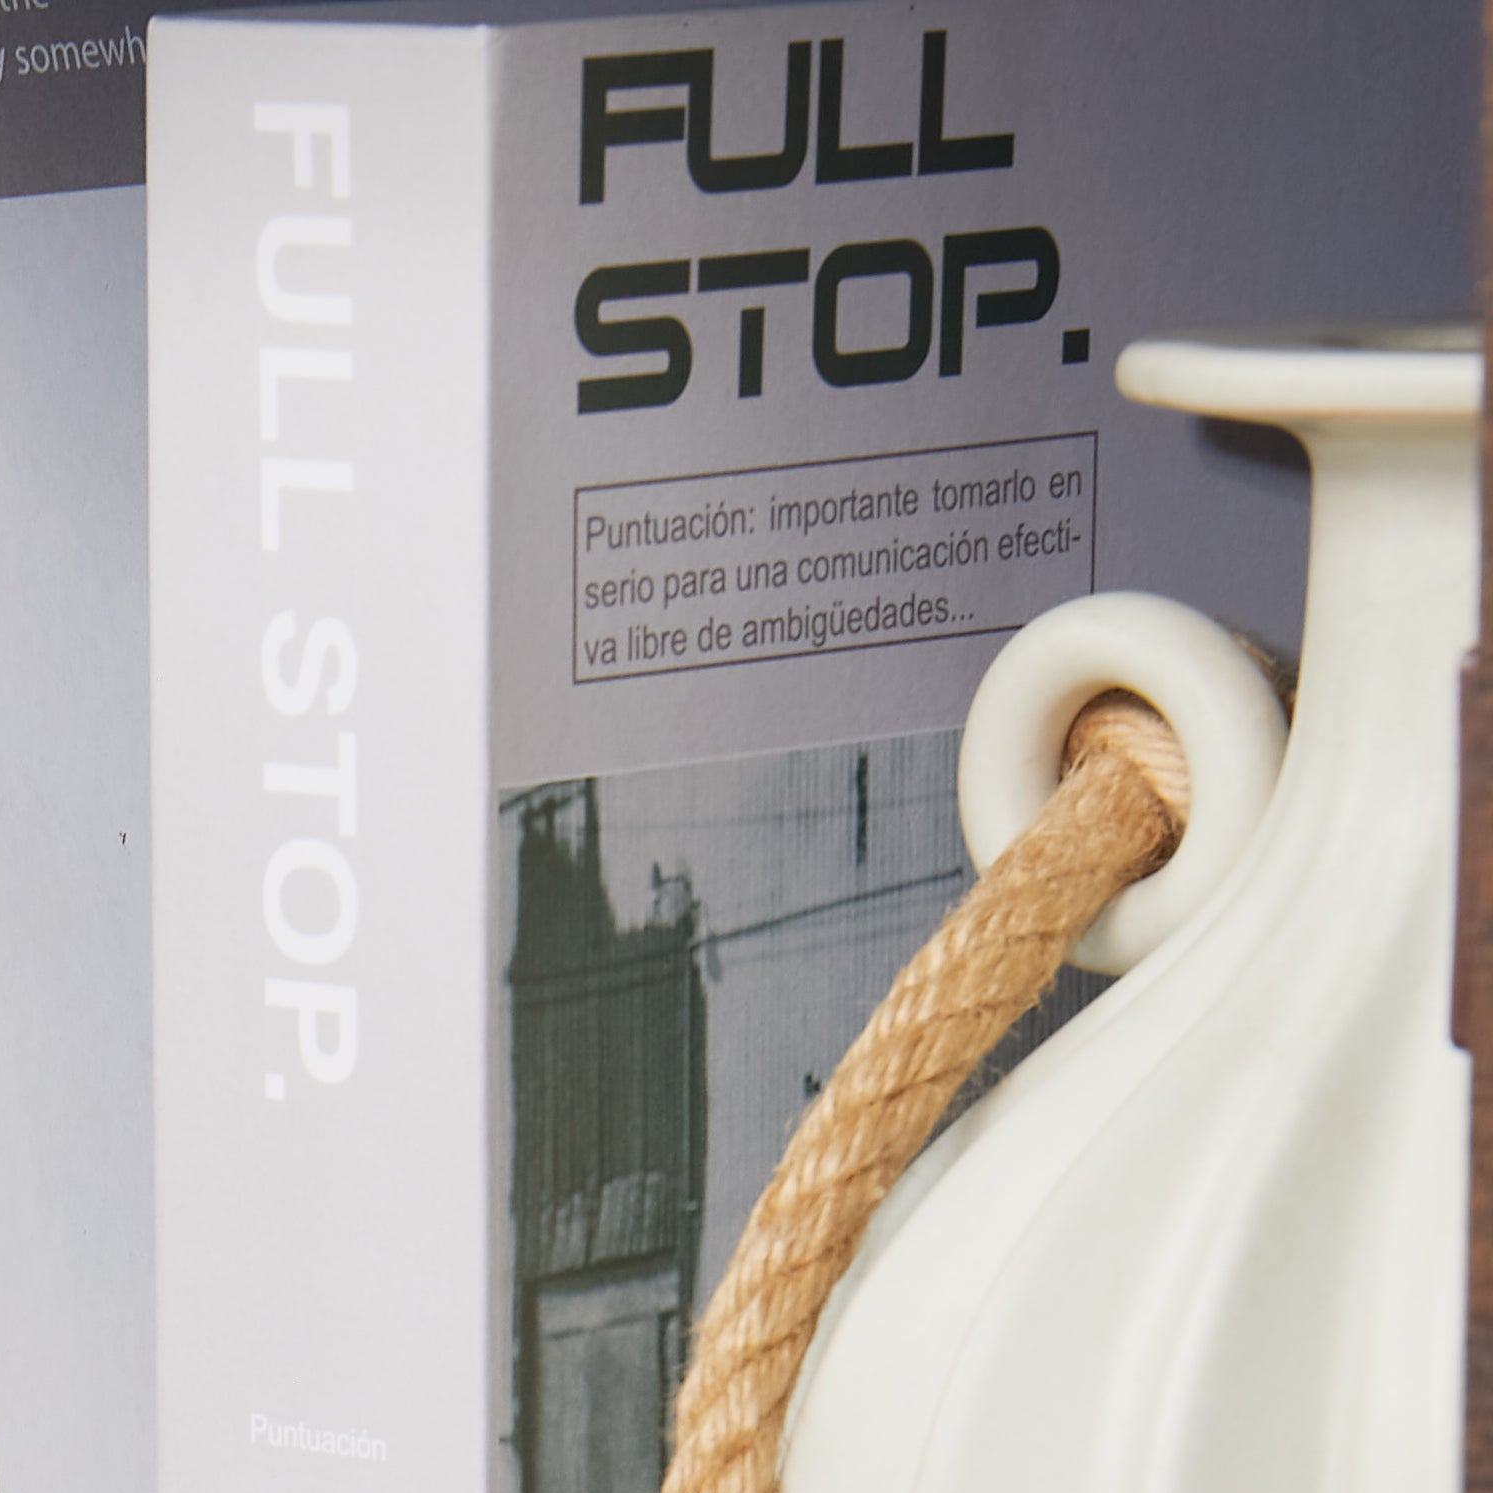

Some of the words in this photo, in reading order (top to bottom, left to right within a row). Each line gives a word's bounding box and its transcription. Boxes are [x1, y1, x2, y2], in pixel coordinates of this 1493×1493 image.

[14, 24, 147, 76] somewh
[578, 29, 1015, 206] FULL
[253, 101, 355, 553] FULL
[573, 226, 1091, 416] STOP.
[585, 501, 756, 552] Puntuación:
[769, 482, 919, 537] importante
[932, 468, 1036, 513] tomarlo
[1048, 469, 1083, 499] en
[584, 568, 655, 610] serio
[663, 566, 727, 611] para
[736, 559, 788, 593] una
[797, 529, 989, 585] comunicación
[997, 517, 1082, 562] efecti-
[584, 636, 617, 667] va
[627, 624, 688, 662] libre
[697, 616, 732, 653] de
[741, 591, 975, 648] ambigüedades...
[260, 608, 360, 1101] STOP.
[249, 1412, 387, 1462] Puntuación
